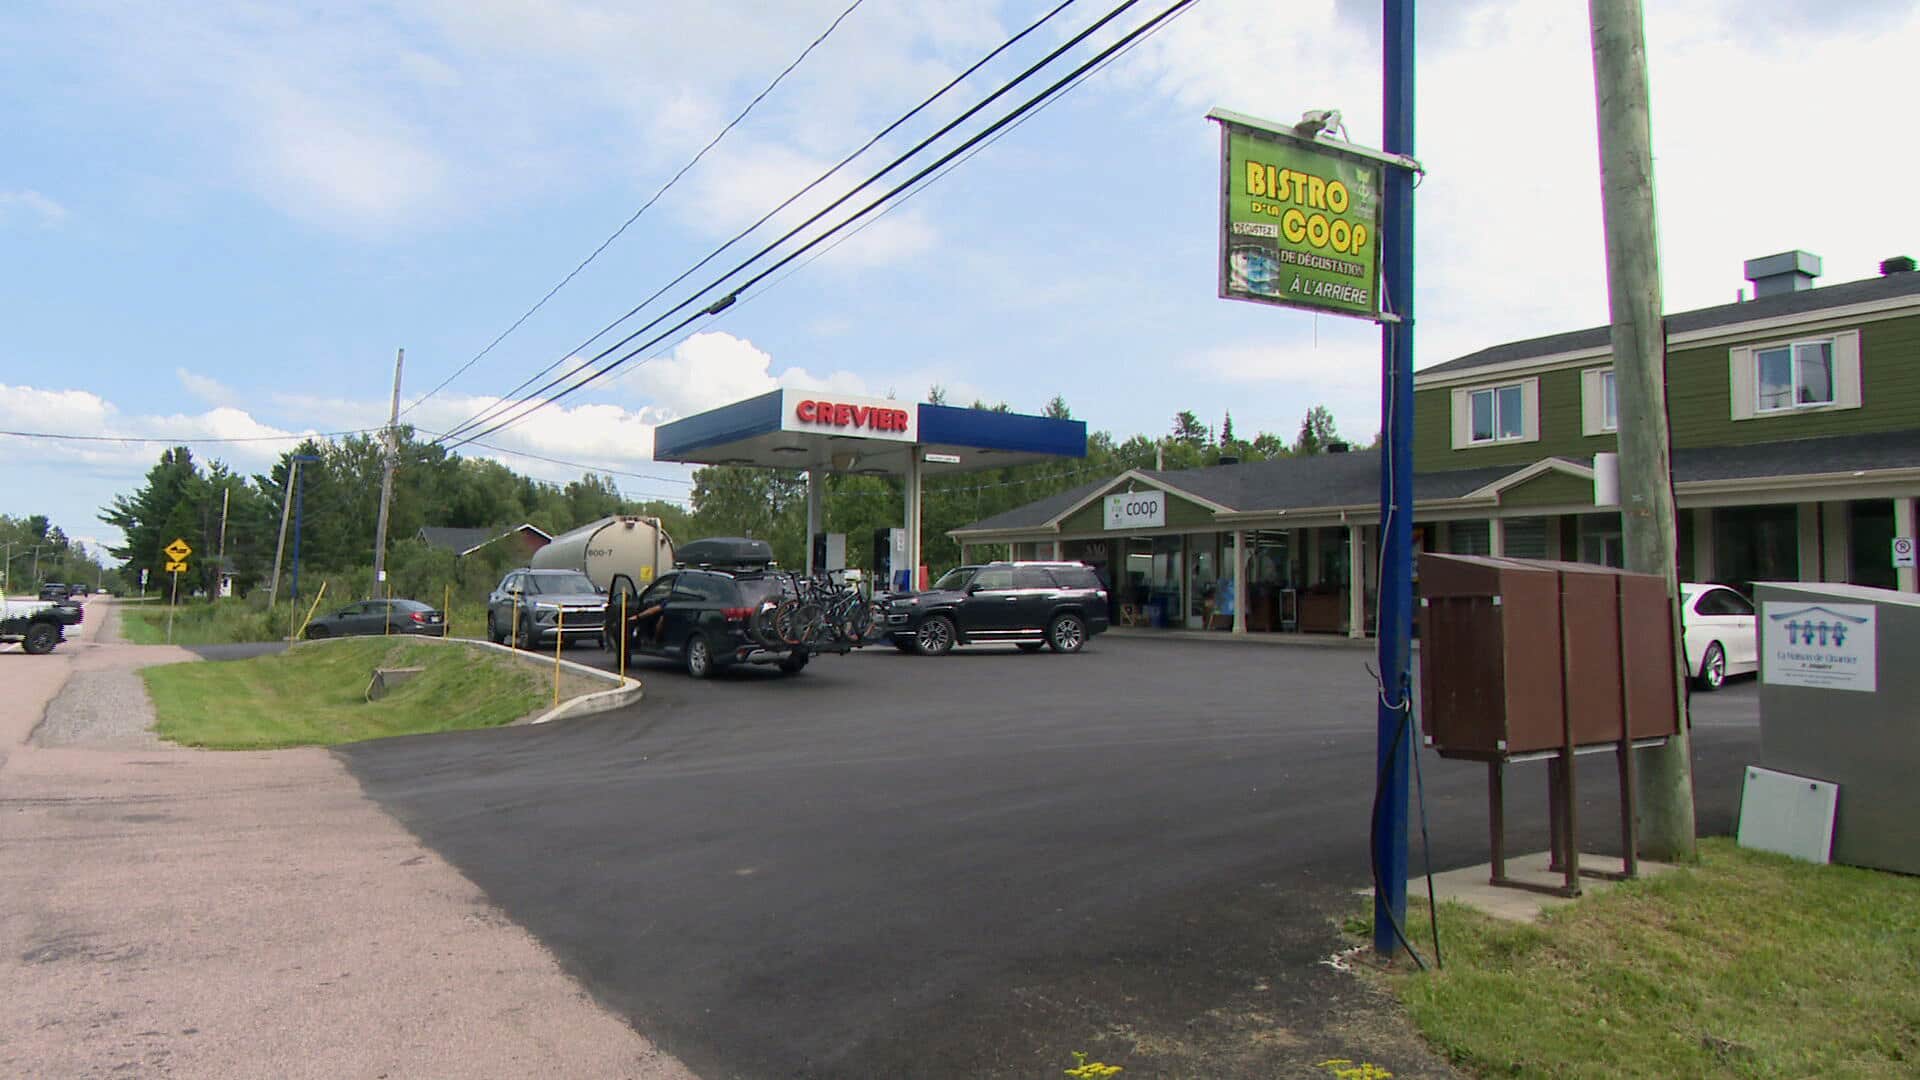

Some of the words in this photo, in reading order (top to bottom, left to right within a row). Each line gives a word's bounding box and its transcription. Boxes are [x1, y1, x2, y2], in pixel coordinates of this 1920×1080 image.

[1245, 160, 1349, 214] BISTRO
[1281, 208, 1367, 256] COOP
[1281, 250, 1297, 263] DE
[1297, 252, 1365, 278] DÉGUSTATION
[1289, 273, 1300, 293] À
[1303, 279, 1367, 304] L'ARRIÈRE
[797, 400, 908, 431] CREVIER
[1127, 501, 1157, 519] coop
